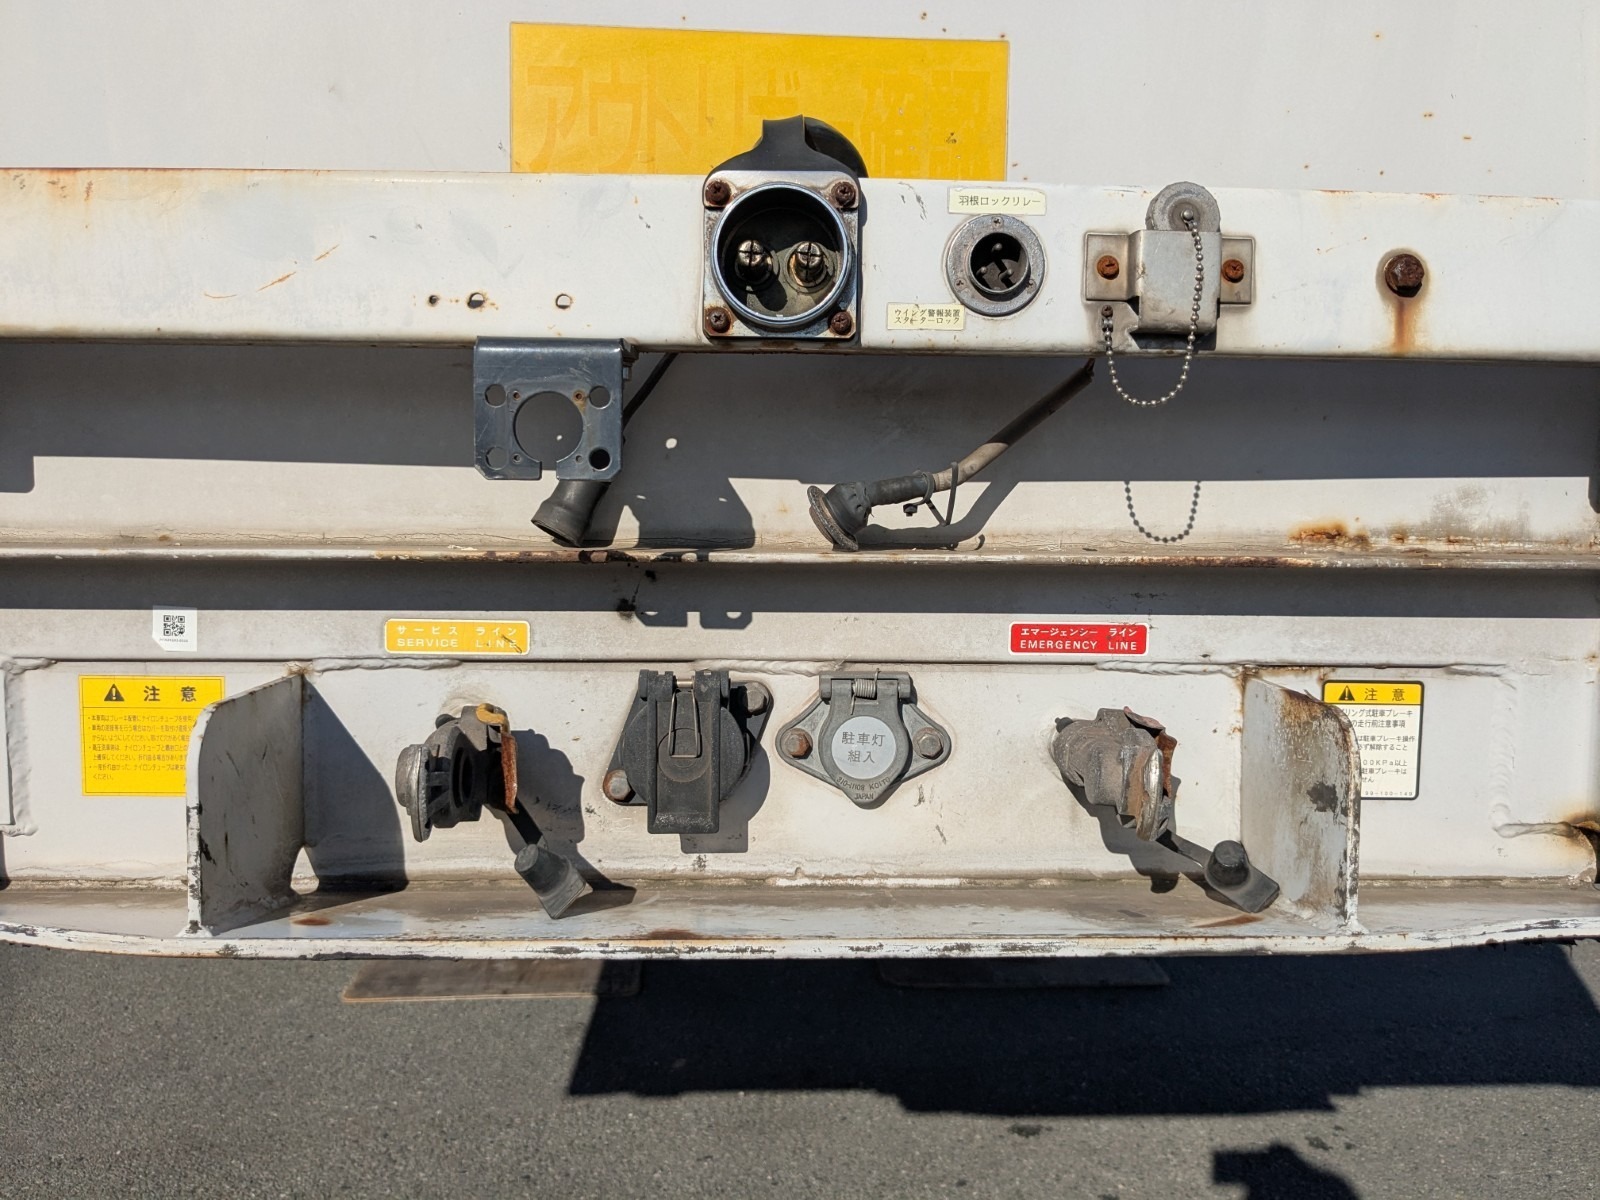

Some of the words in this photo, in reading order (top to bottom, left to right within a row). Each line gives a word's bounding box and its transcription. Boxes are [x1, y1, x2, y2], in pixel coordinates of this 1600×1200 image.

[959, 194, 1041, 206] 羽根ロックリレー
[894, 308, 961, 317] ウイング警報装置
[894, 316, 960, 325] スターターロック
[397, 625, 458, 636] サービス
[475, 626, 517, 636] ライン
[1020, 627, 1099, 637] エマージェンシー
[1108, 627, 1138, 637] ライン
[396, 638, 458, 648] SERVICE
[475, 639, 518, 649] LINE
[1020, 640, 1098, 650] EMERGENCY
[1108, 641, 1138, 651] LINE
[841, 731, 886, 747] 駐車灯
[847, 750, 876, 764] 組入
[868, 776, 891, 791] KOITO
[854, 792, 874, 800] JAPAN
